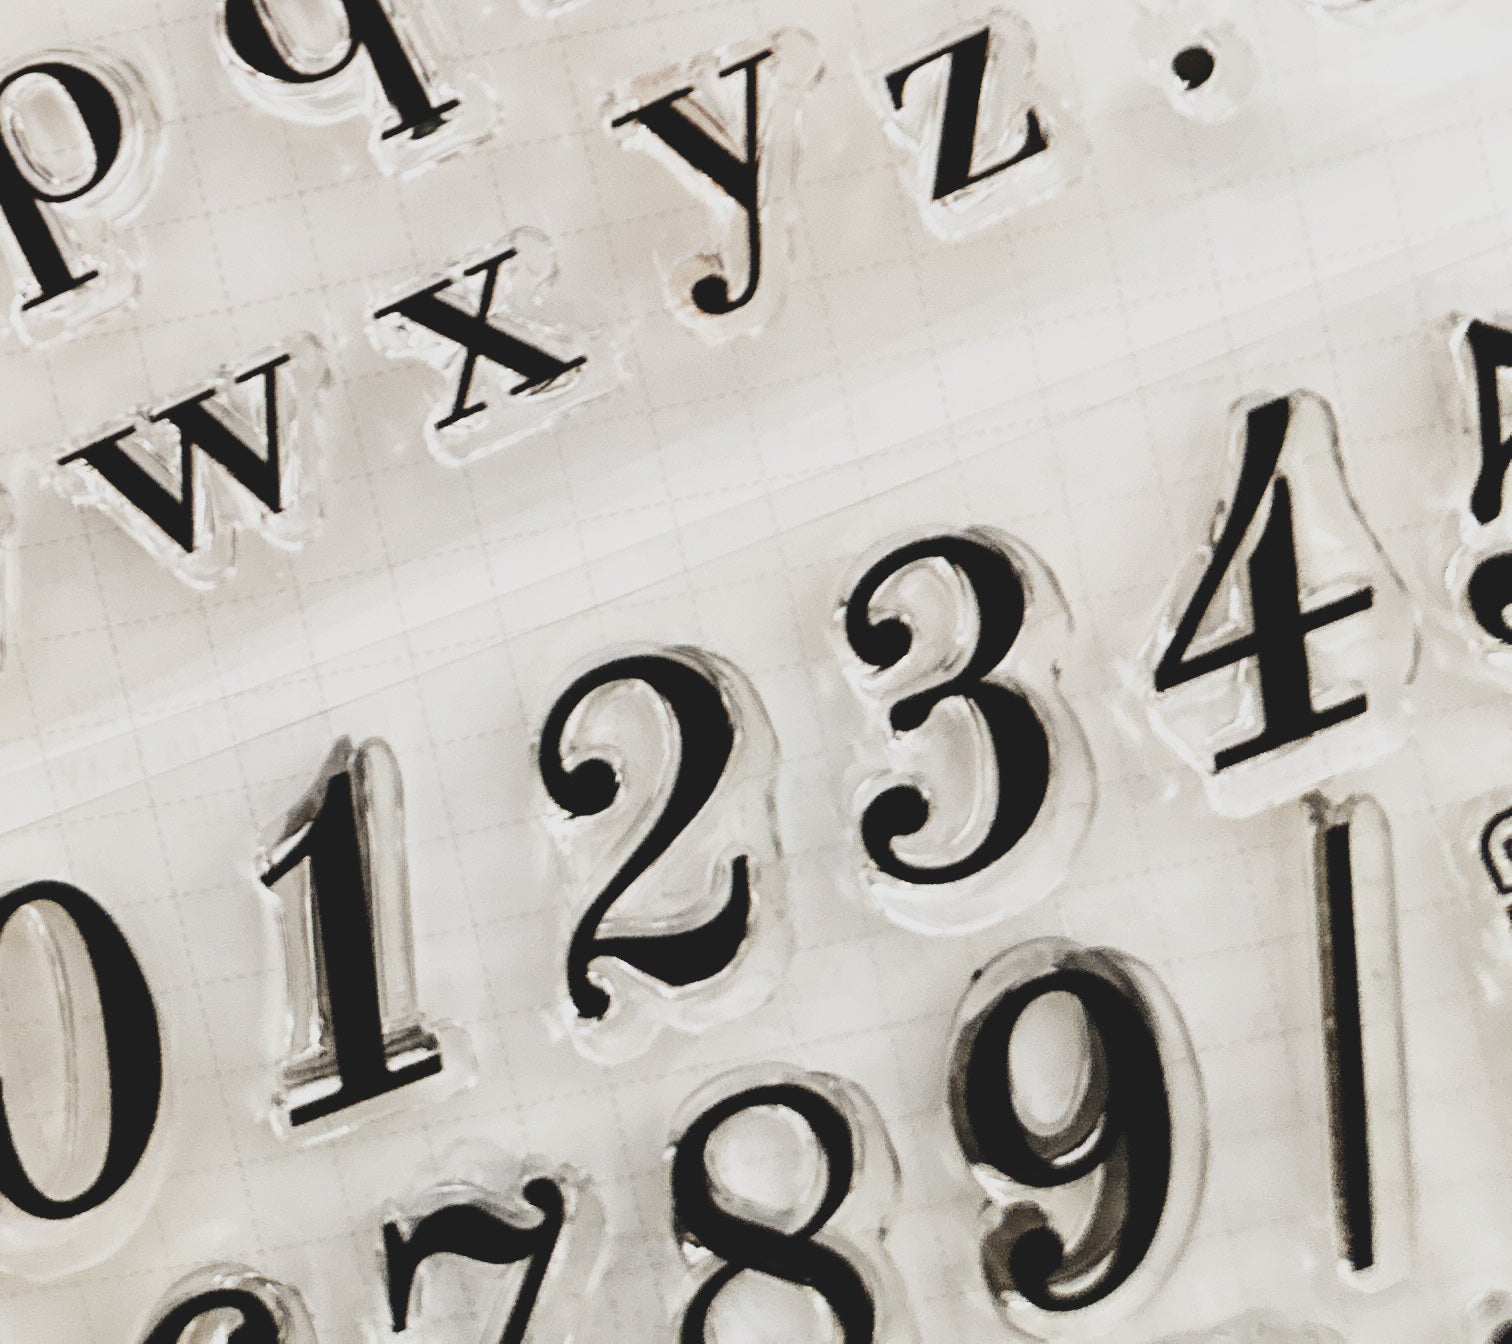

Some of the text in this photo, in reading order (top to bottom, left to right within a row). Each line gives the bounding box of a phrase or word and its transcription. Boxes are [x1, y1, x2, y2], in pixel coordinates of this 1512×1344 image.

[57, 353, 291, 555] w
[373, 248, 588, 431] x
[610, 49, 774, 316] y
[885, 26, 1049, 201] z
[259, 767, 444, 1128] 1
[537, 654, 752, 1022] 2
[843, 535, 1052, 886] 3
[1153, 394, 1375, 773] 4
[668, 1082, 876, 1344] 8
[950, 947, 1173, 1312] 9
